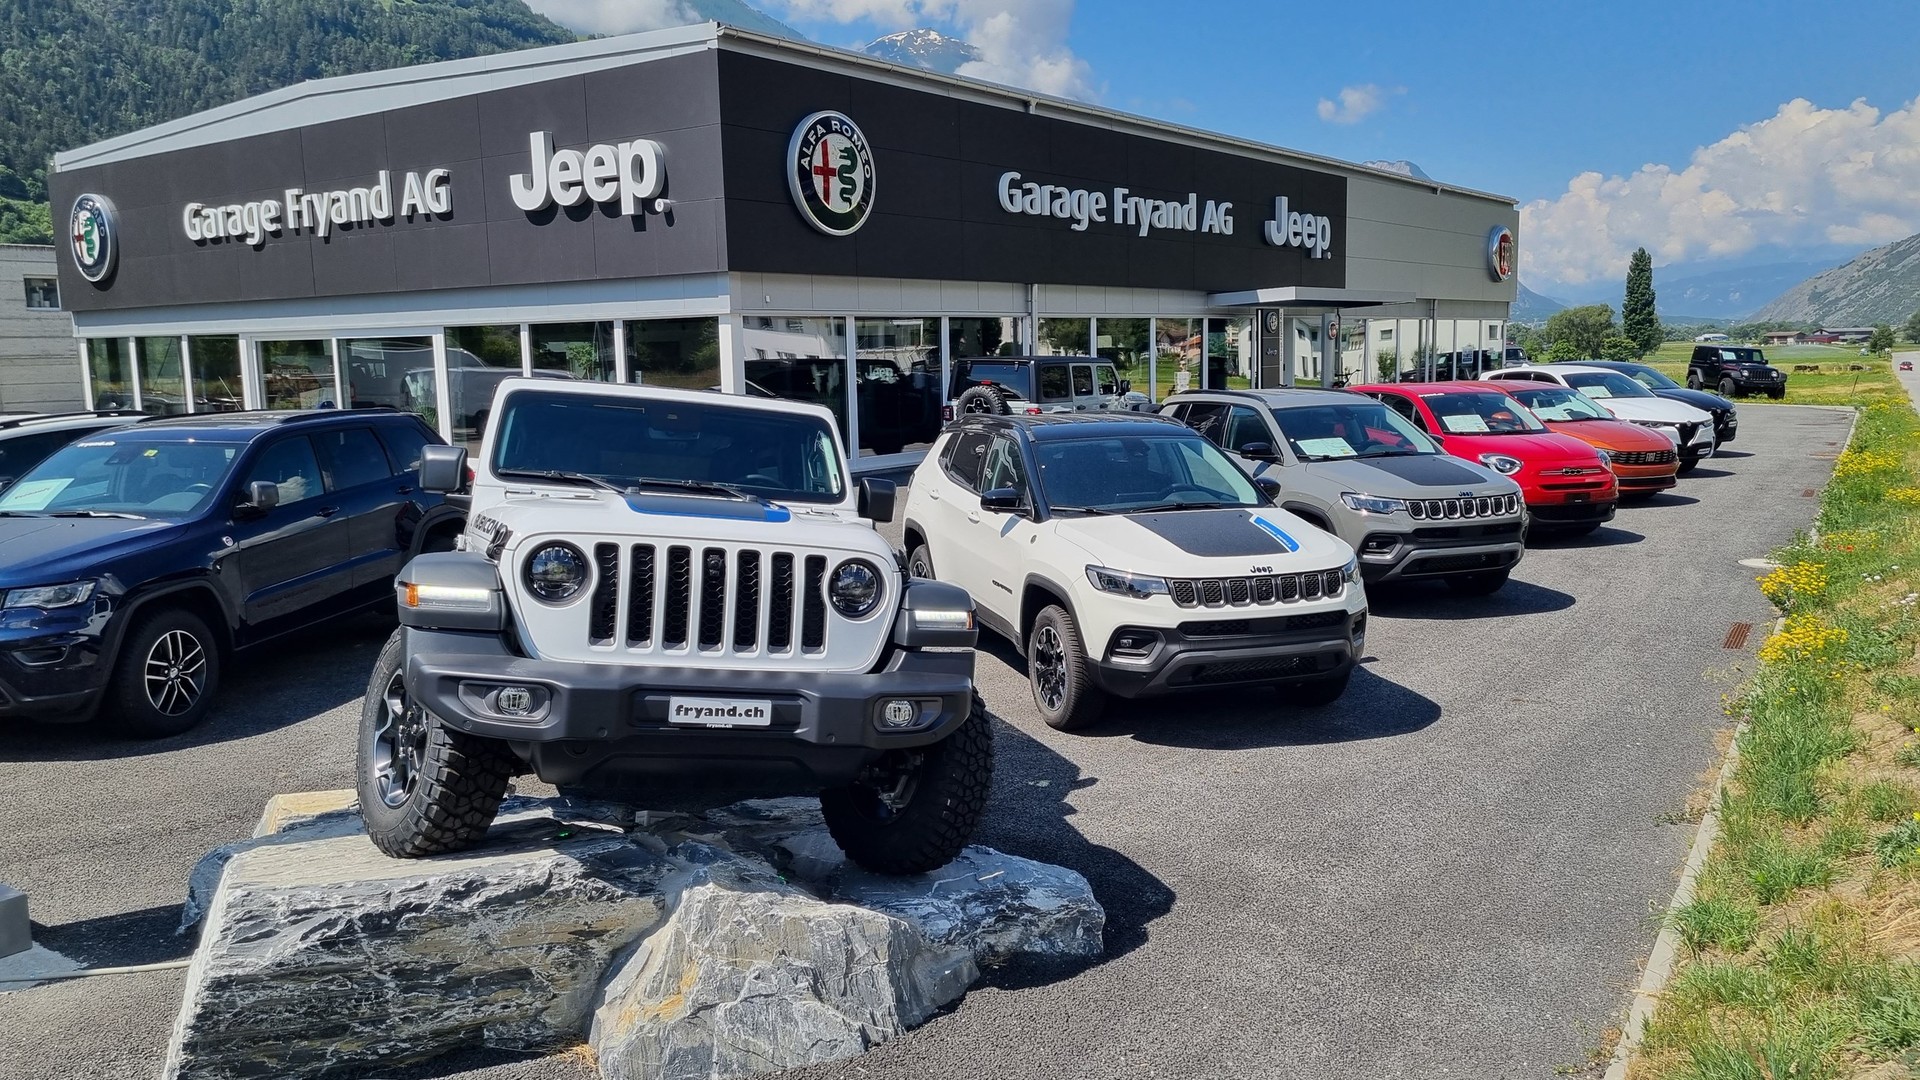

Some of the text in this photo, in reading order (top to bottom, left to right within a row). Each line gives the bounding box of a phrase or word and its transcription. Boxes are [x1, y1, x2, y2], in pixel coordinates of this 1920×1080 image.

[510, 131, 665, 215] Jeep
[801, 120, 871, 178] ALFA ROMEO
[183, 168, 452, 245] Garage Fryand AG
[998, 171, 1234, 237] Garage Fryand AG
[1264, 196, 1331, 259] Jeep
[1250, 565, 1273, 573] Jeep
[675, 704, 764, 719] fryand.ch
